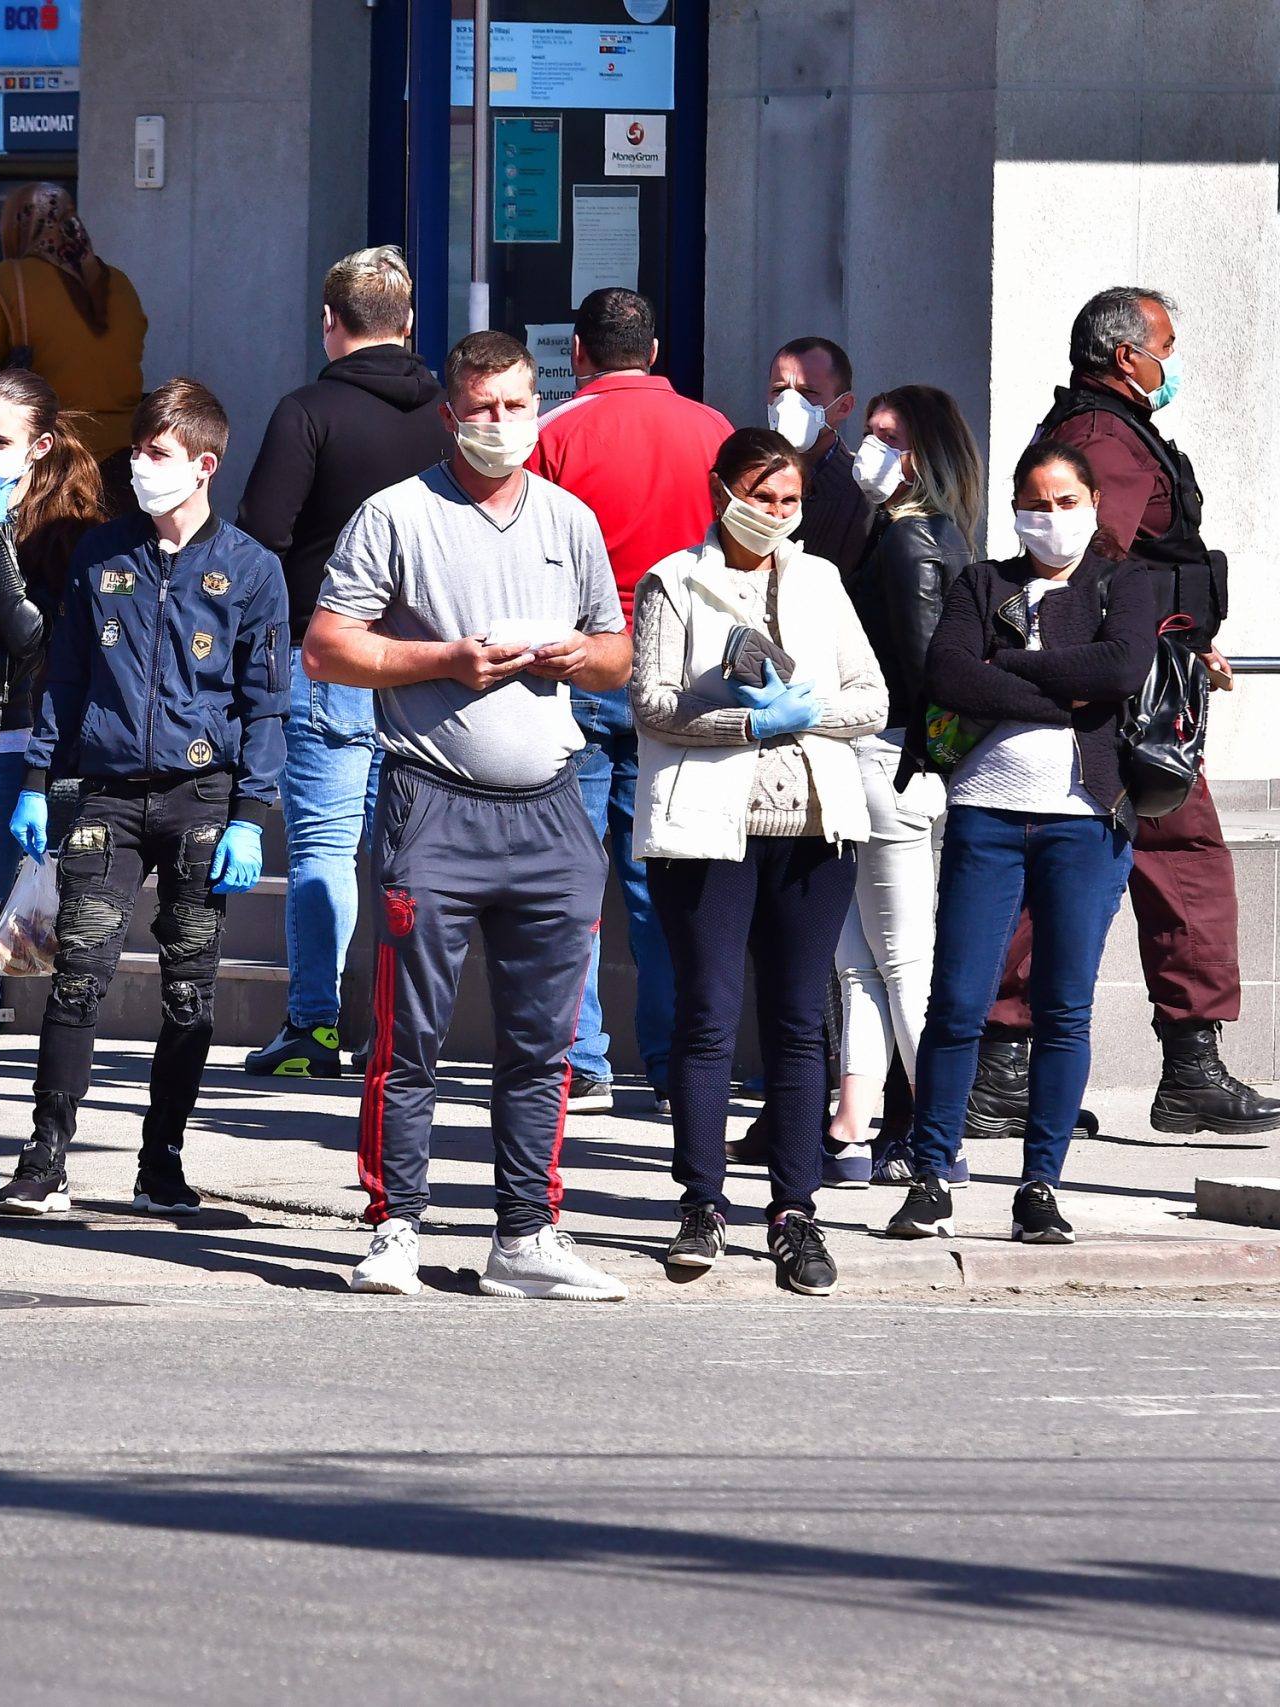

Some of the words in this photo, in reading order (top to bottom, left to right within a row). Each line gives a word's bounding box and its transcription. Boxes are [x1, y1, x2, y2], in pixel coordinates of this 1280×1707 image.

[4, 6, 38, 31] BCR
[9, 115, 75, 133] BANCOMAT
[611, 151, 659, 163] MoneyGram
[538, 366, 575, 378] Pentru
